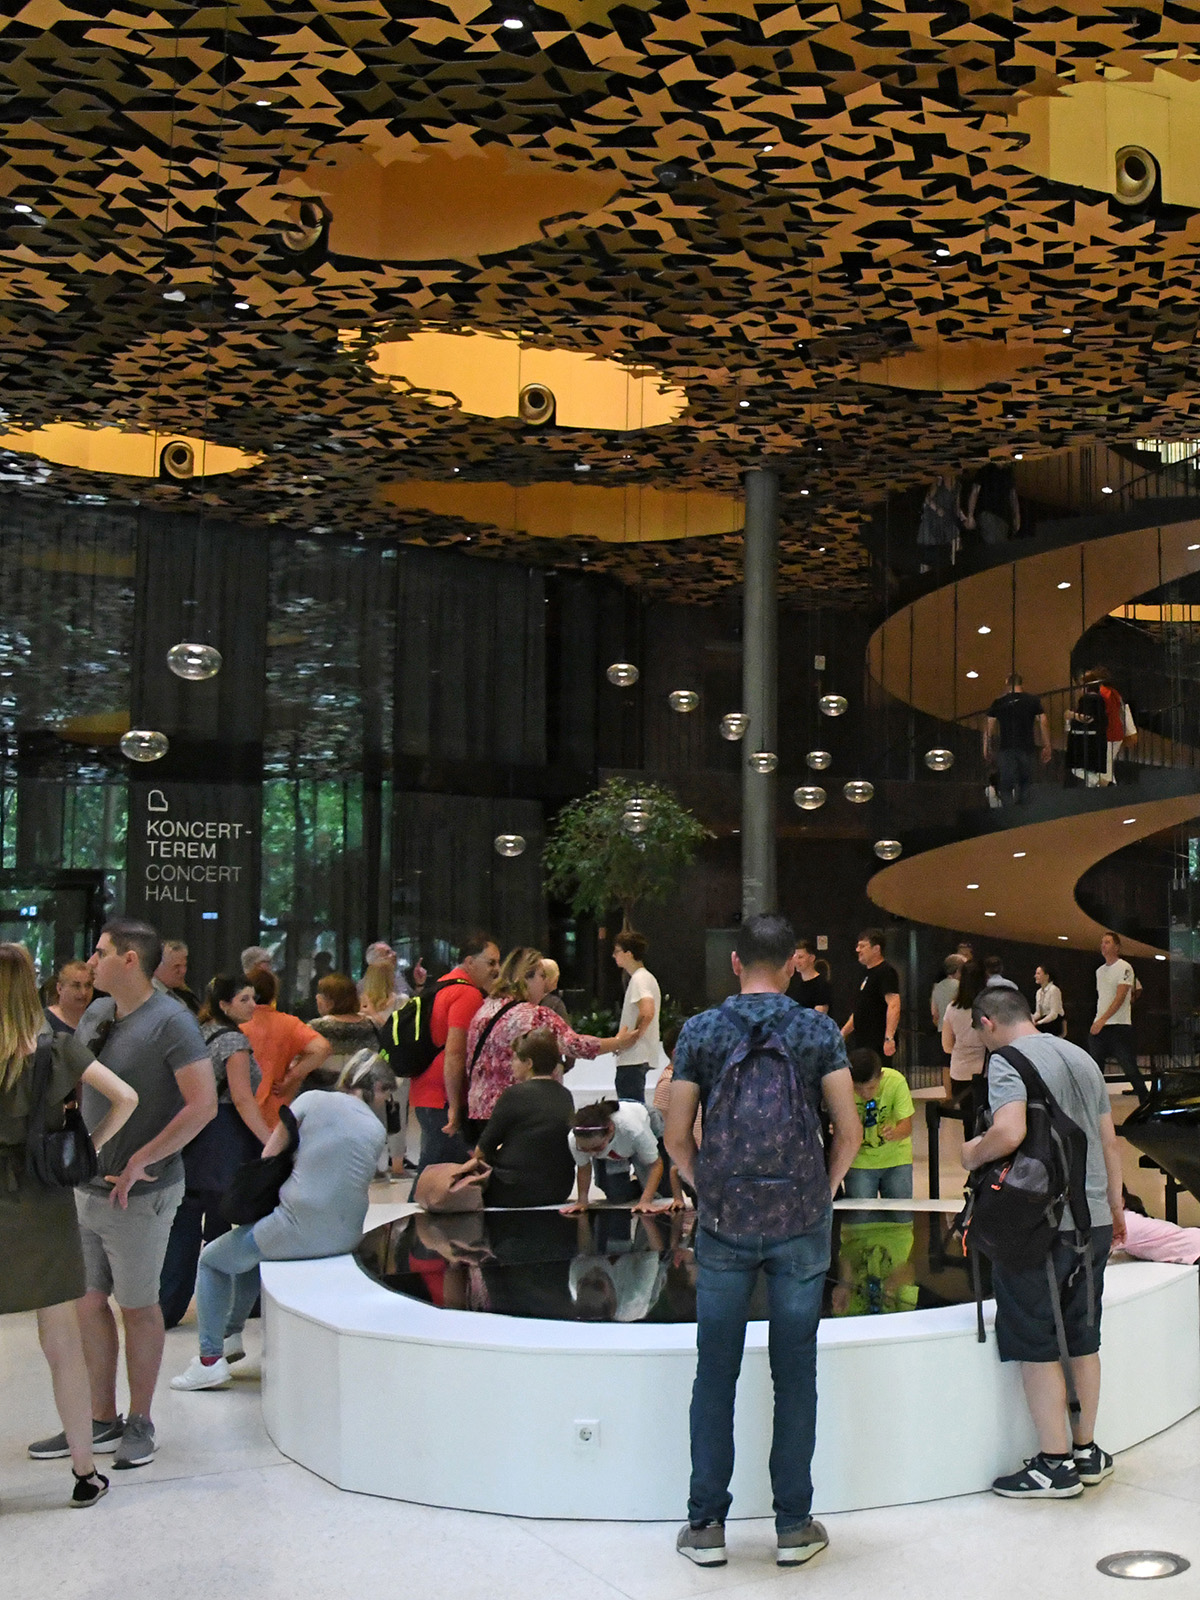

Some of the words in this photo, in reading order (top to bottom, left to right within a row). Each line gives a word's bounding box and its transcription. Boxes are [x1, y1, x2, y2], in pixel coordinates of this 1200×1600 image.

[146, 820, 252, 839] KONCERT-
[146, 841, 217, 859] TEREM
[145, 864, 243, 882] CONCERT
[145, 885, 198, 902] HALL
